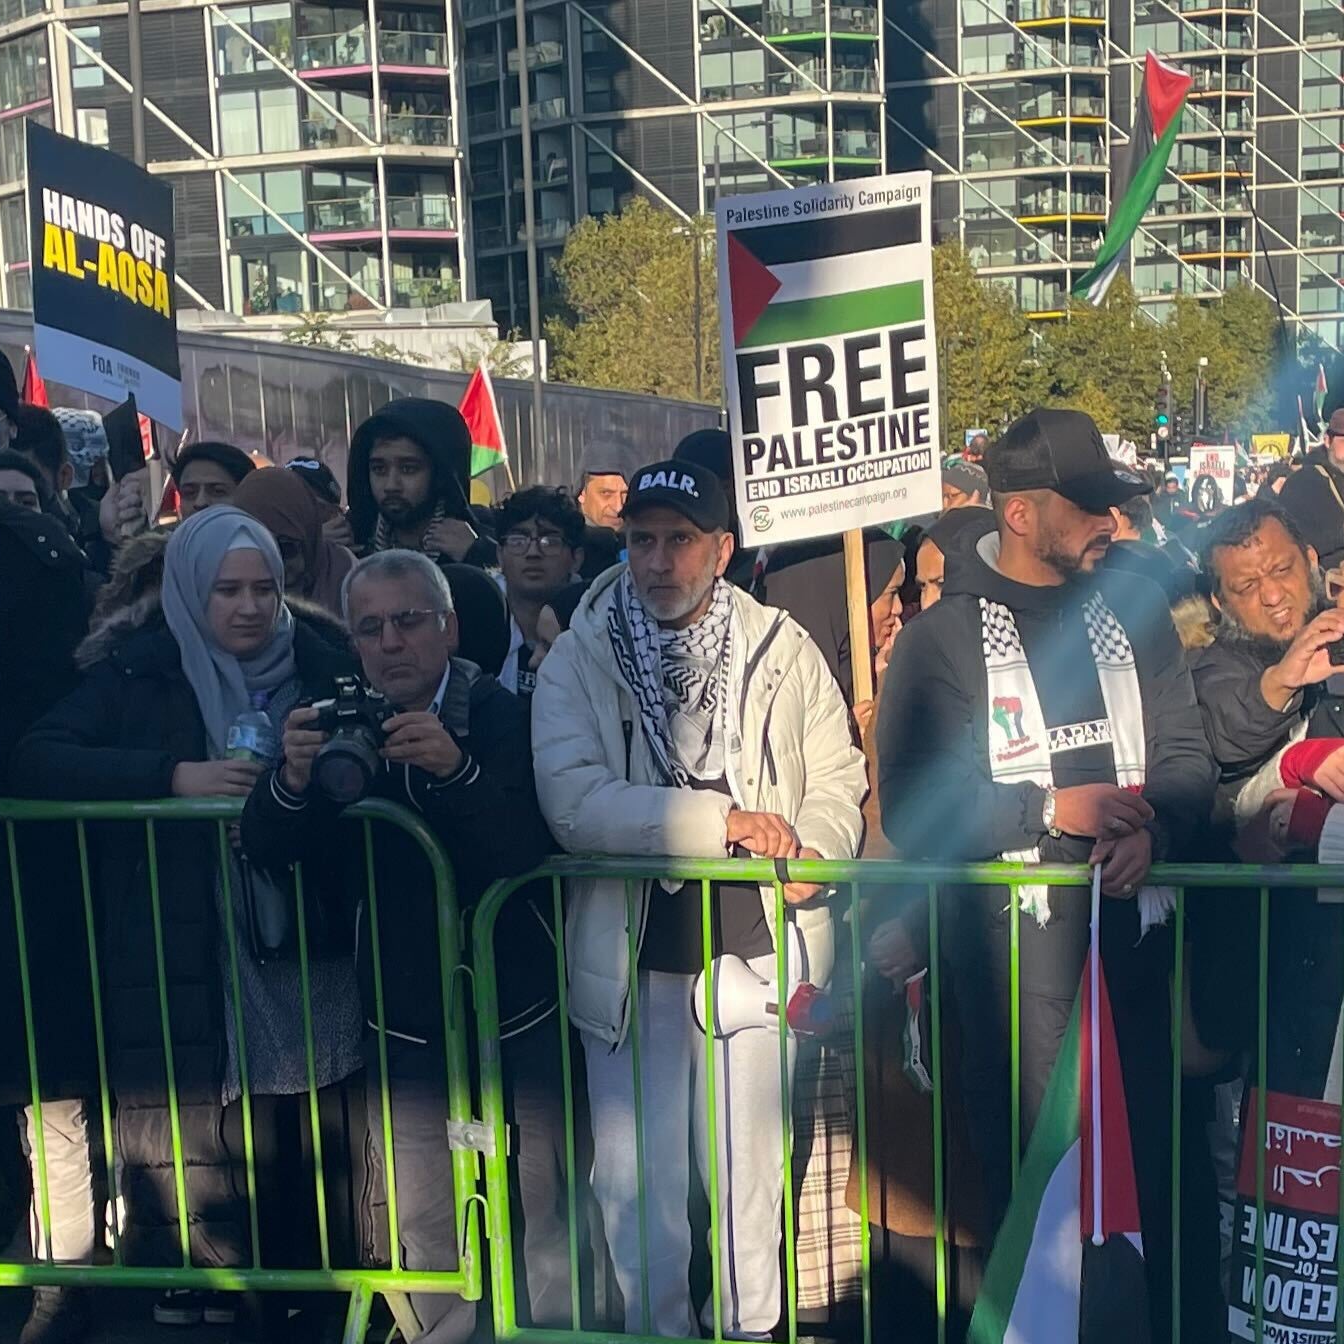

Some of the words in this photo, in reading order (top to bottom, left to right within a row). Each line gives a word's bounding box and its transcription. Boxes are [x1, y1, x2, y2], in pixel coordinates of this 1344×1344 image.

[726, 203, 789, 224] Palestine
[793, 193, 855, 217] Solidarity
[858, 184, 922, 208] Campaign
[42, 187, 126, 250] HANDS
[130, 223, 166, 270] OFF
[43, 222, 171, 319] AL-AQSA
[92, 354, 113, 376] FOA
[735, 324, 930, 435] FREE
[742, 408, 931, 476] PALESTINE
[638, 471, 699, 498] BALR.
[748, 480, 781, 501] END
[784, 472, 844, 497] ISRAELI
[846, 450, 931, 486] OCCUPATION
[780, 487, 908, 521] www.palestinecampaign.org
[1295, 1260, 1319, 1281] for
